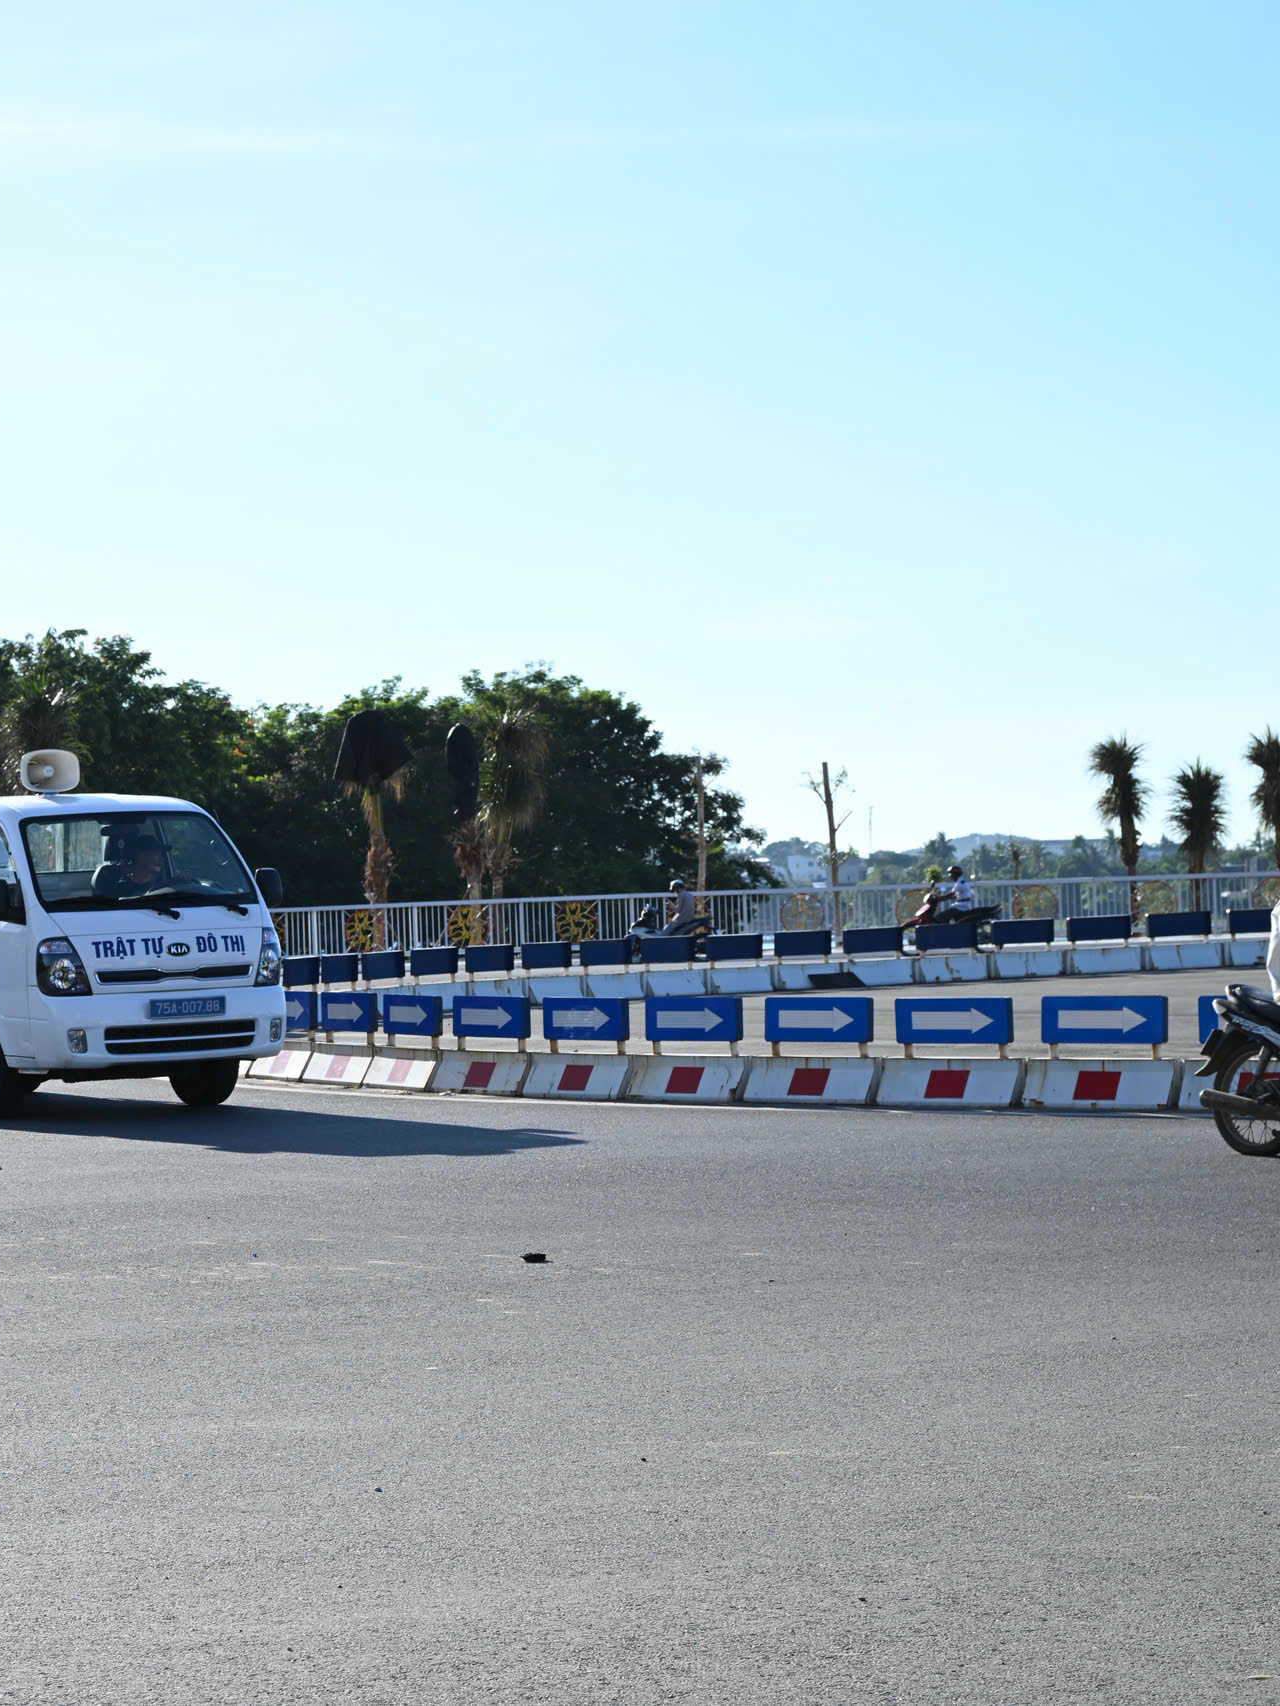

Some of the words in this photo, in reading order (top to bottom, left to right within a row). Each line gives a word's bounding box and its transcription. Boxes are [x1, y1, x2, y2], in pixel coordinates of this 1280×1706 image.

[92, 937, 136, 959] TRẬT
[141, 936, 164, 958] TỰ
[196, 933, 217, 953] ĐÔ
[221, 935, 246, 955] THỊ
[170, 945, 188, 953] KIA
